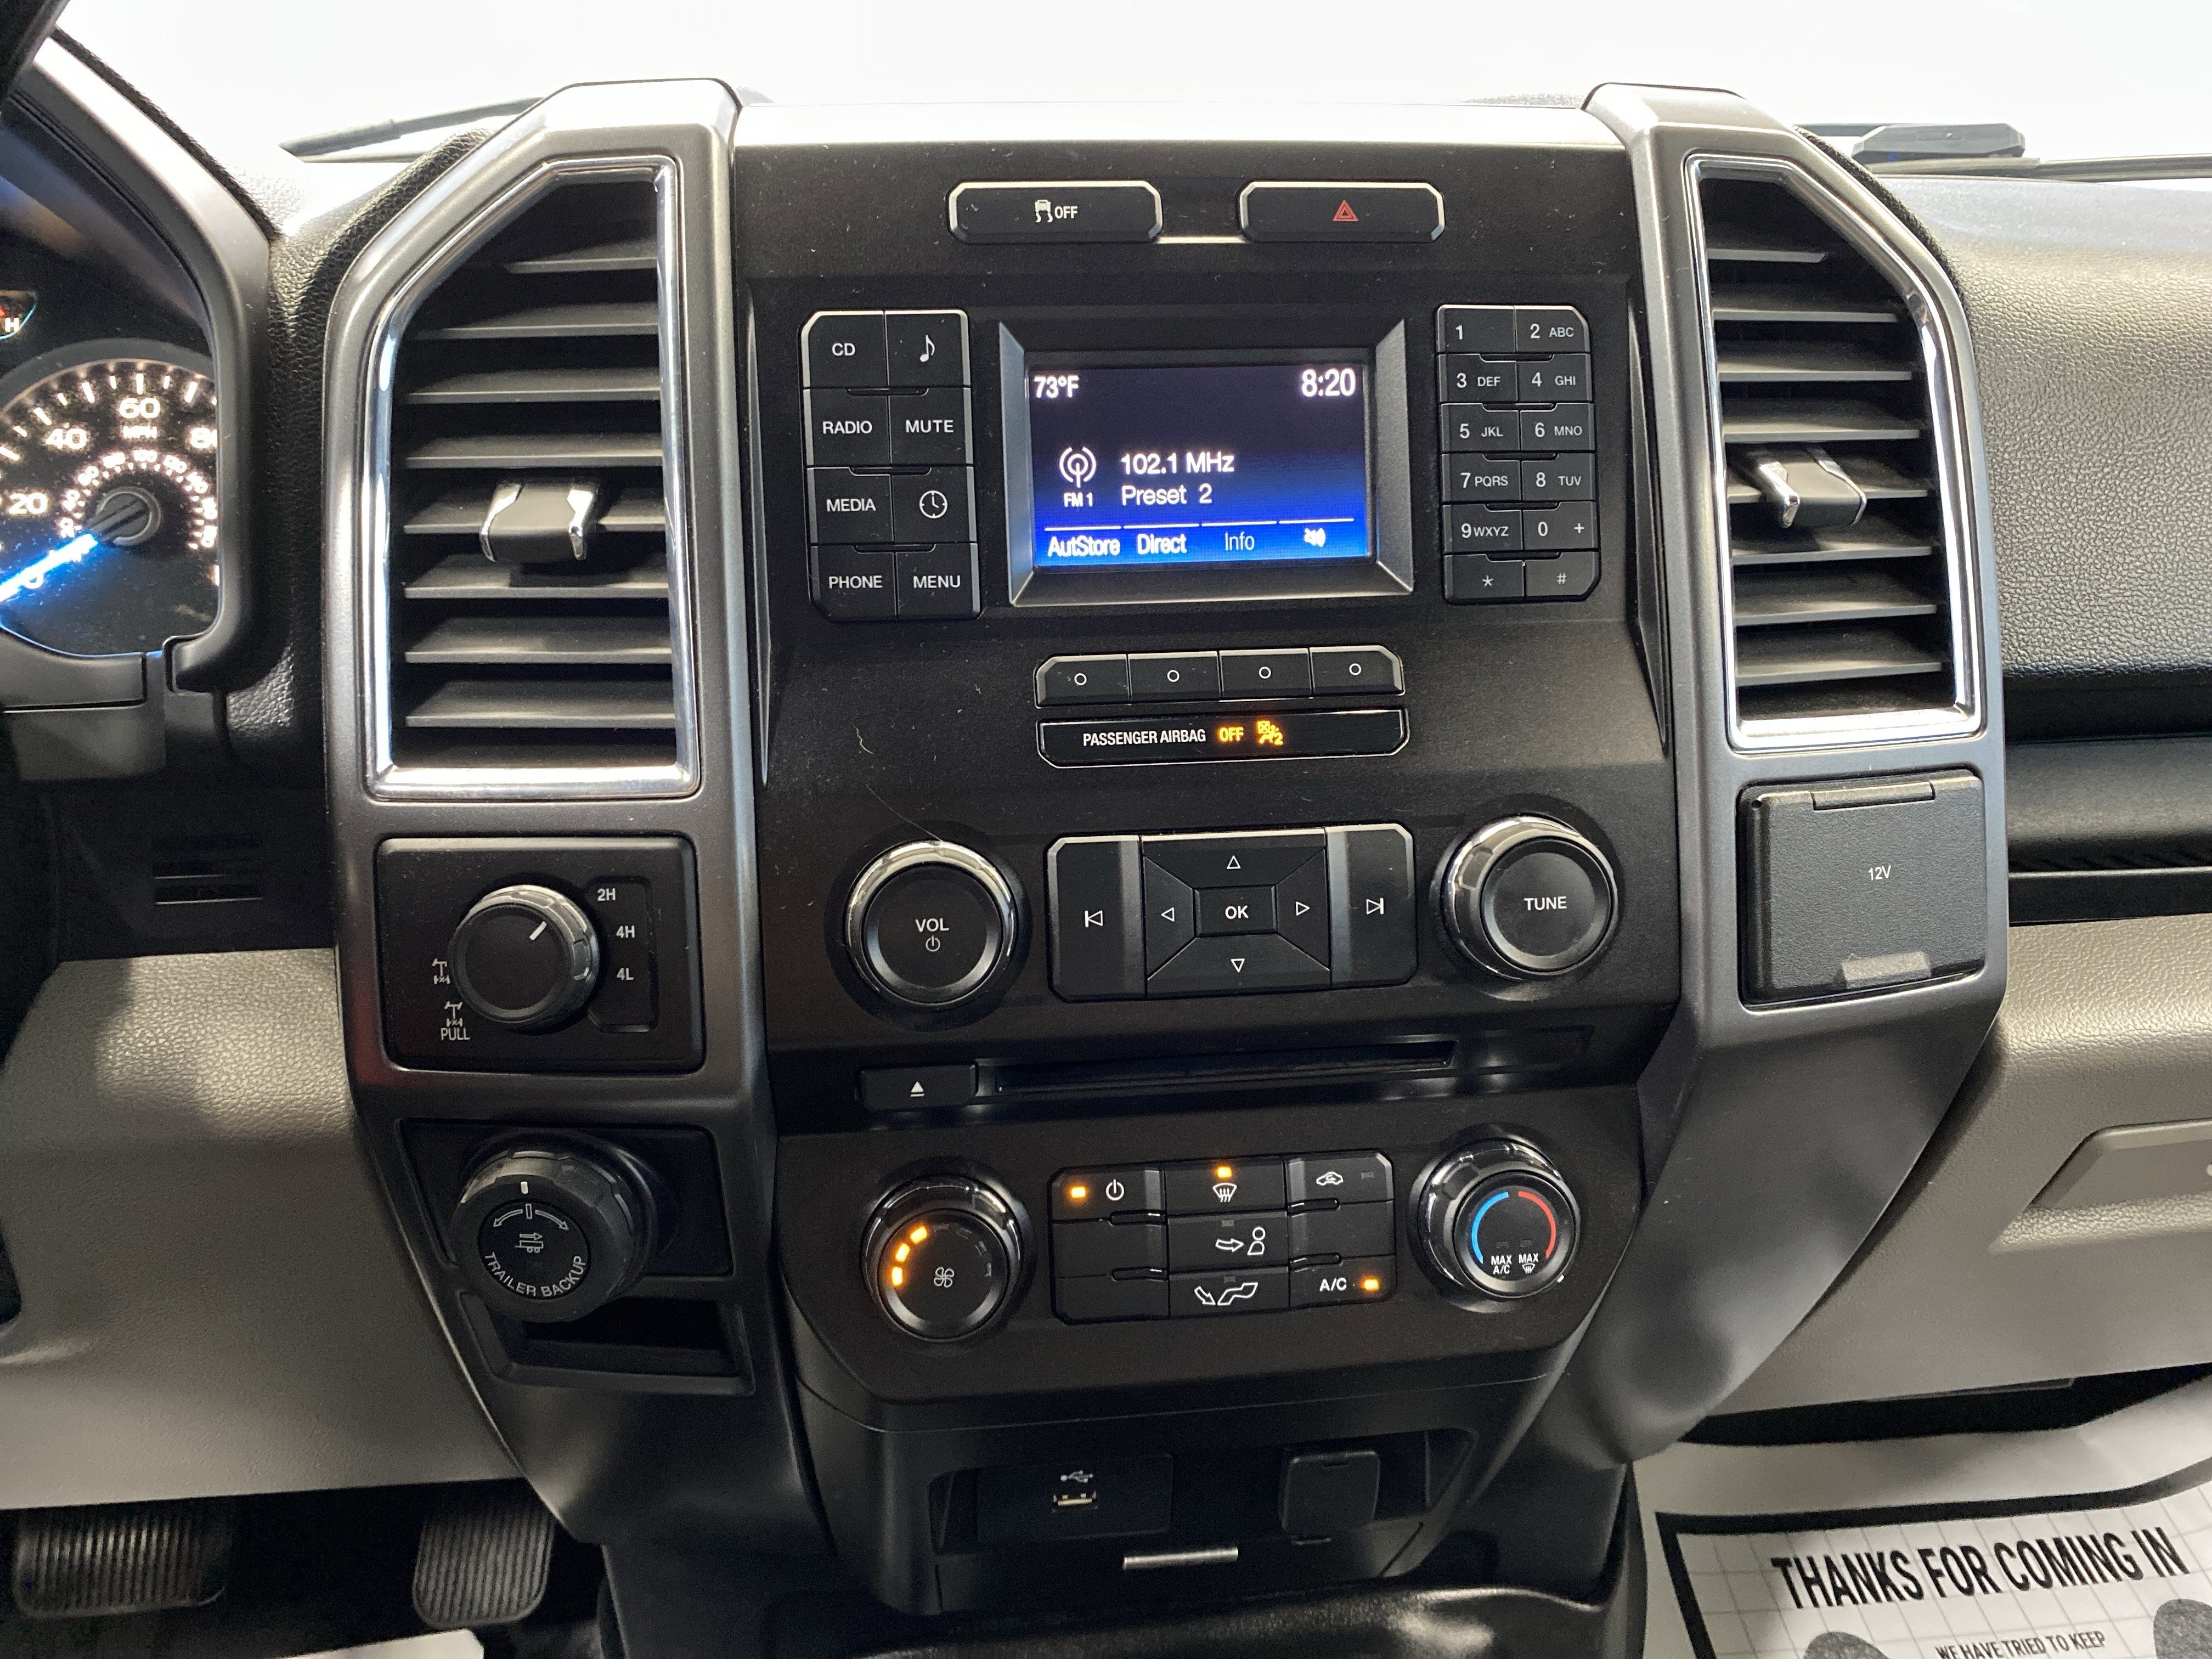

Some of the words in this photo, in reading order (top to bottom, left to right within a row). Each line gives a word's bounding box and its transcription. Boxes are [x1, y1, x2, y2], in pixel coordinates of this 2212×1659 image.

[1054, 205, 1078, 219] OFF
[5, 317, 19, 332] H
[1530, 324, 1541, 339] 2
[1549, 327, 1574, 338] ABC
[1455, 325, 1463, 340] 1
[832, 343, 856, 356] CD
[1034, 375, 1079, 398] 73°F
[1302, 368, 1356, 397] 8:20
[1456, 373, 1467, 388] 3
[1477, 376, 1501, 387] DEF
[1531, 372, 1542, 387] 4
[1555, 376, 1576, 386] GHI
[119, 398, 160, 419] 60
[823, 421, 873, 434] RADIO
[906, 420, 954, 433] MUTE
[1459, 423, 1470, 439] 5
[1481, 427, 1504, 437] JKL
[1534, 422, 1545, 438] 6
[1554, 426, 1583, 436] MNO
[45, 428, 88, 450] 40
[190, 427, 218, 449] 8
[1121, 453, 1178, 475] 102.1
[1187, 452, 1235, 473] MHz
[1460, 472, 1471, 488] 7
[1475, 476, 1508, 487] PQRS
[1536, 472, 1547, 488] 8
[1558, 476, 1582, 486] TUV
[1064, 493, 1082, 507] FM
[1087, 493, 1093, 506] 1
[1122, 484, 1187, 506] Preset
[1199, 483, 1212, 504] 2
[8, 493, 48, 515] 20
[826, 498, 876, 512] MEDIA
[1461, 523, 1472, 539] 9
[1474, 526, 1509, 537] WXYZ
[1538, 521, 1548, 537] 0
[1047, 536, 1121, 557] AutStore
[1137, 533, 1187, 555] Direct
[1224, 531, 1255, 552] Info
[829, 575, 883, 589] PHONE
[913, 575, 961, 589] MENU
[1083, 730, 1158, 746] PASSENGER
[1160, 729, 1206, 743] AIRBAG
[1219, 727, 1244, 742] OFF
[1868, 865, 1892, 881] 12V
[597, 888, 616, 901] 2H
[1523, 896, 1567, 911] TUNE
[1225, 905, 1249, 920] OK
[616, 926, 635, 938] 4H
[915, 918, 950, 932] VOL
[616, 968, 634, 981] 4L
[441, 1028, 470, 1041] PULL
[1491, 1255, 1512, 1266] MAX
[1519, 1252, 1539, 1264] MAX
[485, 1251, 537, 1296] TRAILER
[540, 1255, 586, 1297] BACKUP
[1493, 1265, 1510, 1275] A/C
[1319, 1277, 1347, 1291] A/C
[1771, 1548, 1924, 1609] THANKS
[1918, 1545, 2002, 1598] FOR
[1994, 1532, 2143, 1592] COMING
[2132, 1526, 2190, 1578] IN
[1935, 1646, 1959, 1659] WE
[1957, 1641, 2004, 1659] HAVE
[2001, 1637, 2047, 1657] TRIED
[2046, 1634, 2070, 1653] TO
[2068, 1630, 2106, 1649] KEEP
